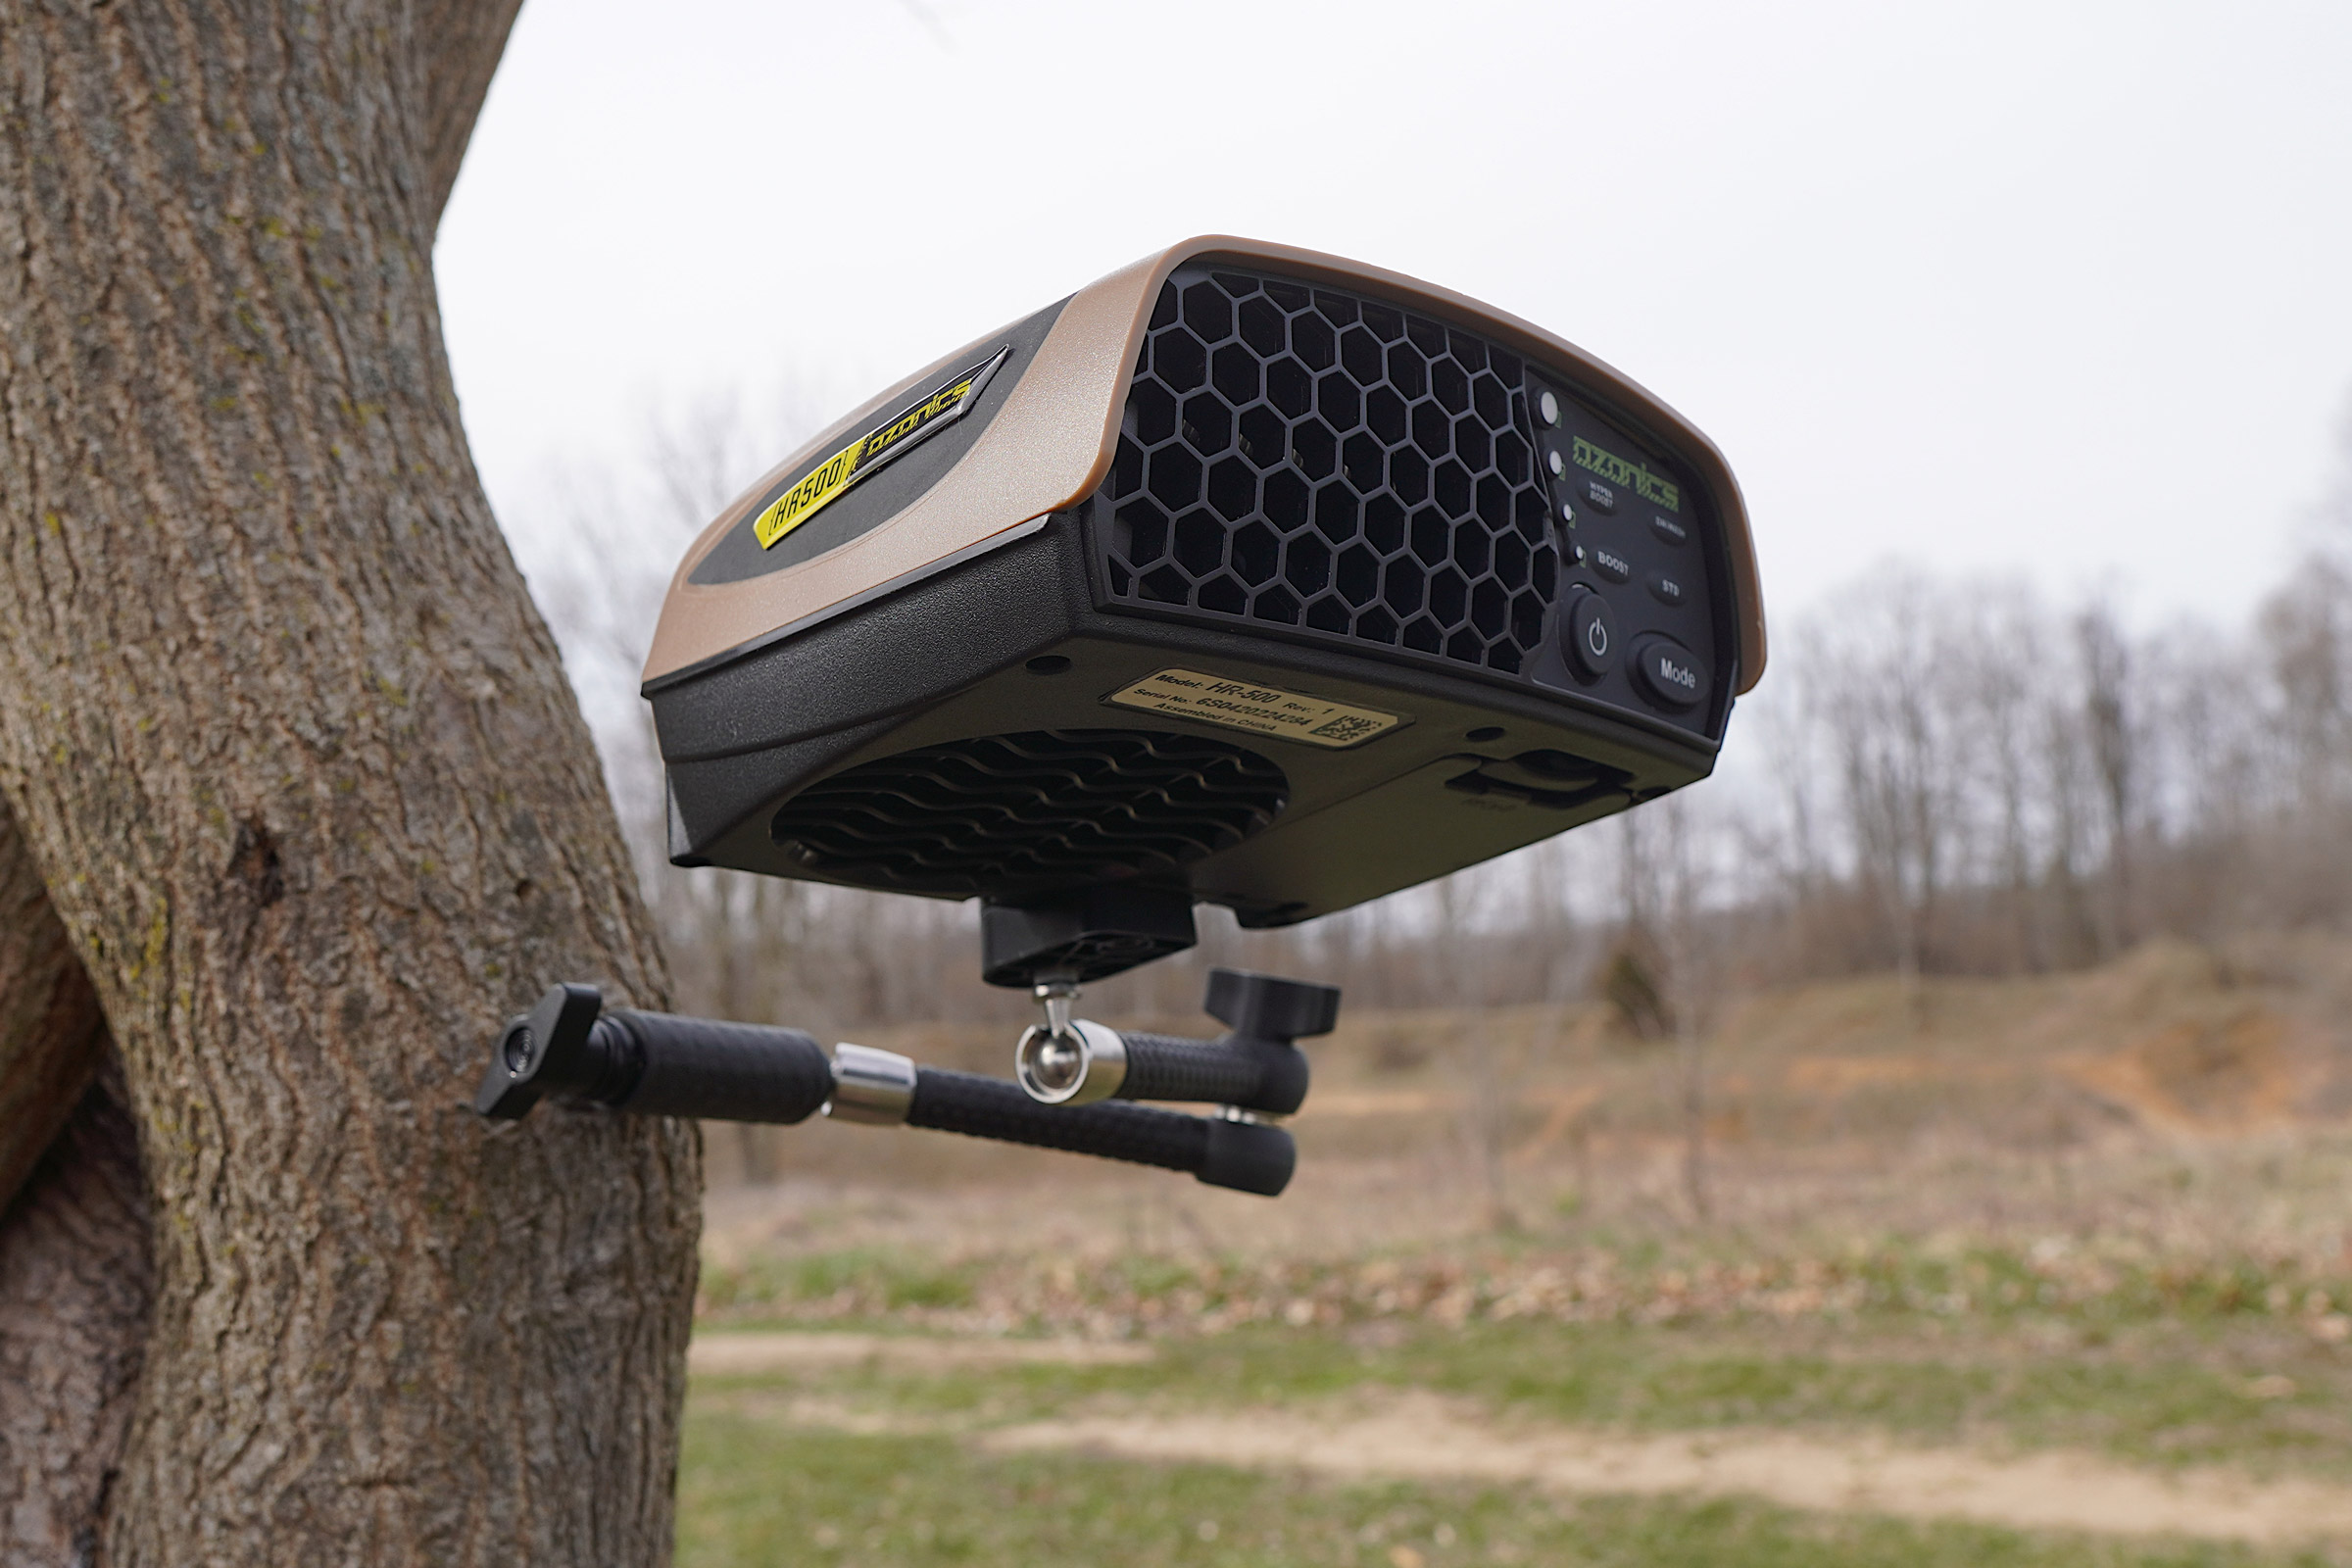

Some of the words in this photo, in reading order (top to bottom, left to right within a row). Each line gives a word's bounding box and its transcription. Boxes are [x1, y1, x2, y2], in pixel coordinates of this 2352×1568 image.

[773, 458, 841, 528] HR500
[866, 378, 971, 457] ozonics
[1573, 436, 1679, 513] ozonics
[1590, 490, 1614, 509] BOOST
[1597, 551, 1629, 576] BOOST
[1662, 579, 1680, 597] STD
[1660, 658, 1695, 689] Mode
[1134, 688, 1171, 700] Serial
[1155, 674, 1203, 689] Model:
[1205, 681, 1282, 704] HR-500
[1153, 703, 1224, 720] Assembled
[1237, 718, 1277, 731] CHINA
